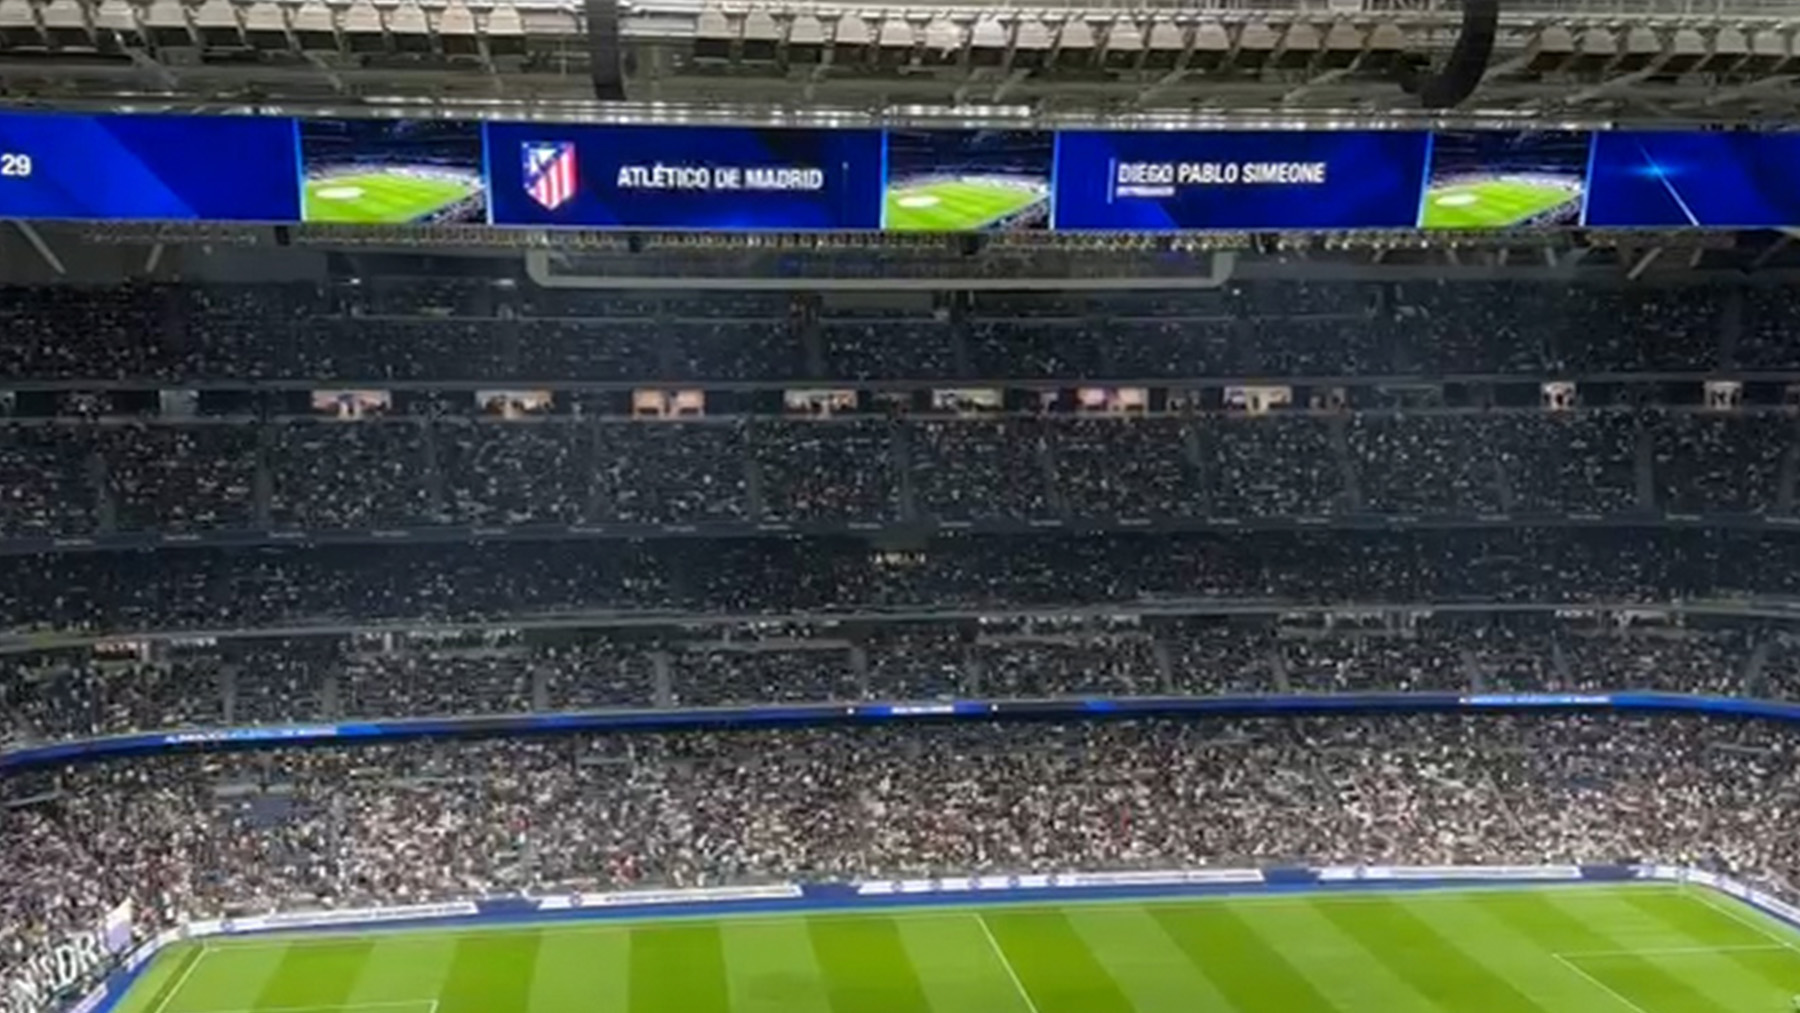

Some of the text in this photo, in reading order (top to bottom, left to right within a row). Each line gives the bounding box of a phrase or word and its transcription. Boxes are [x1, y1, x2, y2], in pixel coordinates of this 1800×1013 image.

[1, 154, 32, 177] 29
[617, 163, 824, 190] ATLÉTICO DE MADRID
[1118, 162, 1326, 184] DIEGO PABLO SIMEONE
